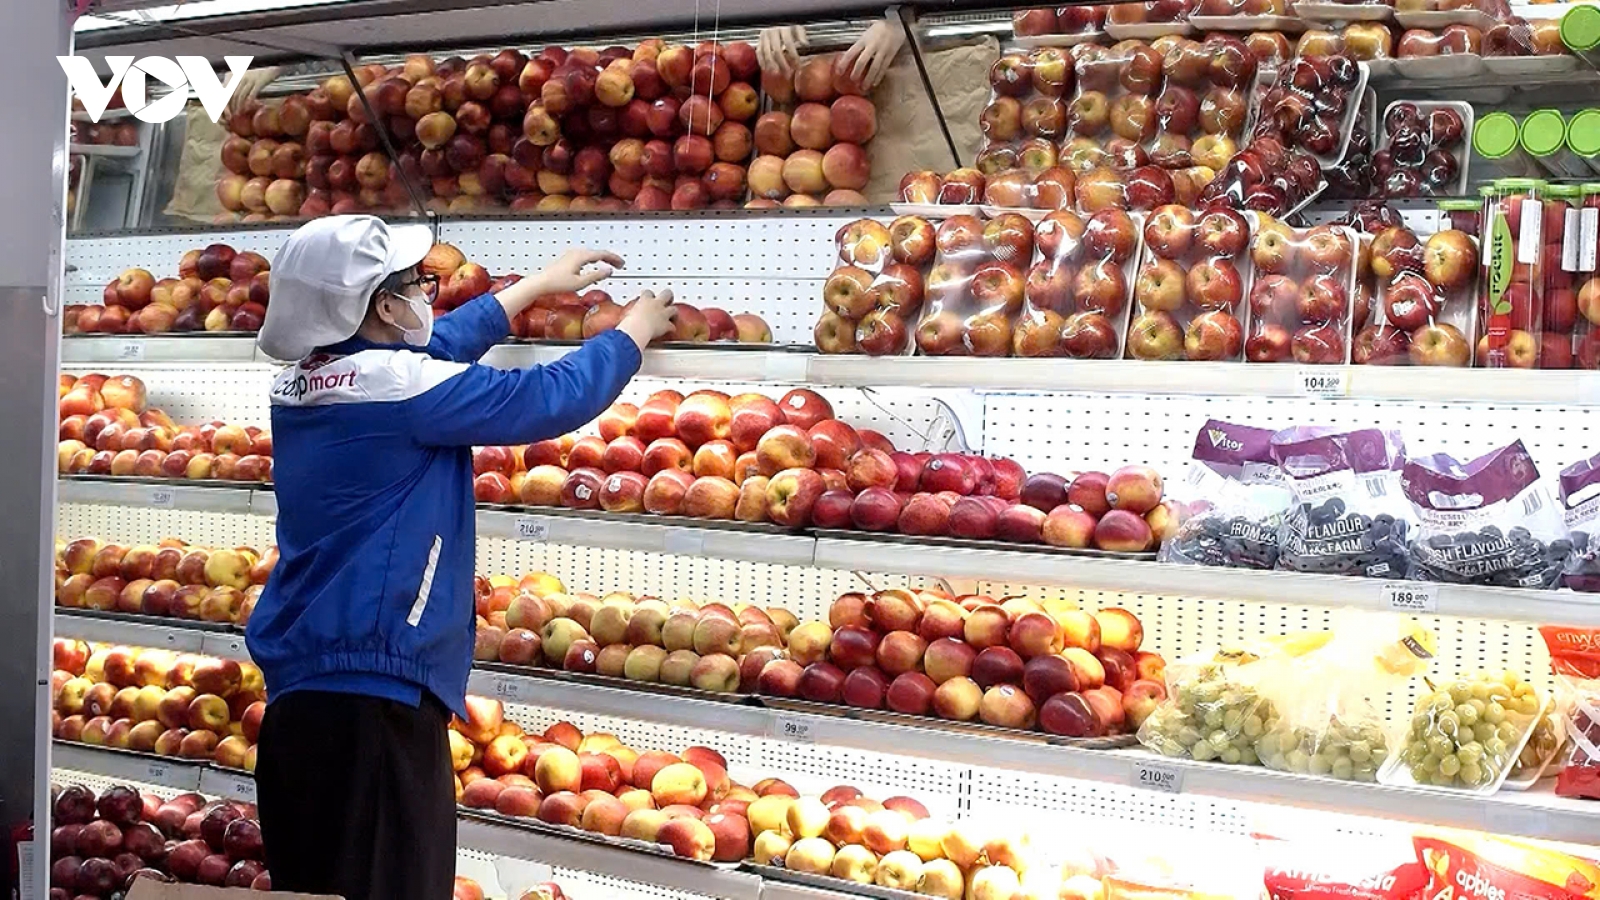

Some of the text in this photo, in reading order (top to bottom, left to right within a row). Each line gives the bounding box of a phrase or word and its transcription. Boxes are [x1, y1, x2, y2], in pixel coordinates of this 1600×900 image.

[1492, 233, 1503, 293] rockit
[1230, 521, 1261, 540] FROM
[1302, 518, 1364, 539] FLAVOUR
[1327, 538, 1363, 553] FARM
[1454, 537, 1512, 558] FLAVOUR
[1477, 555, 1514, 573] FARM
[1391, 591, 1413, 603] 189
[1556, 632, 1593, 652] envy
[1140, 769, 1161, 782] 210
[1456, 869, 1506, 900] apples
